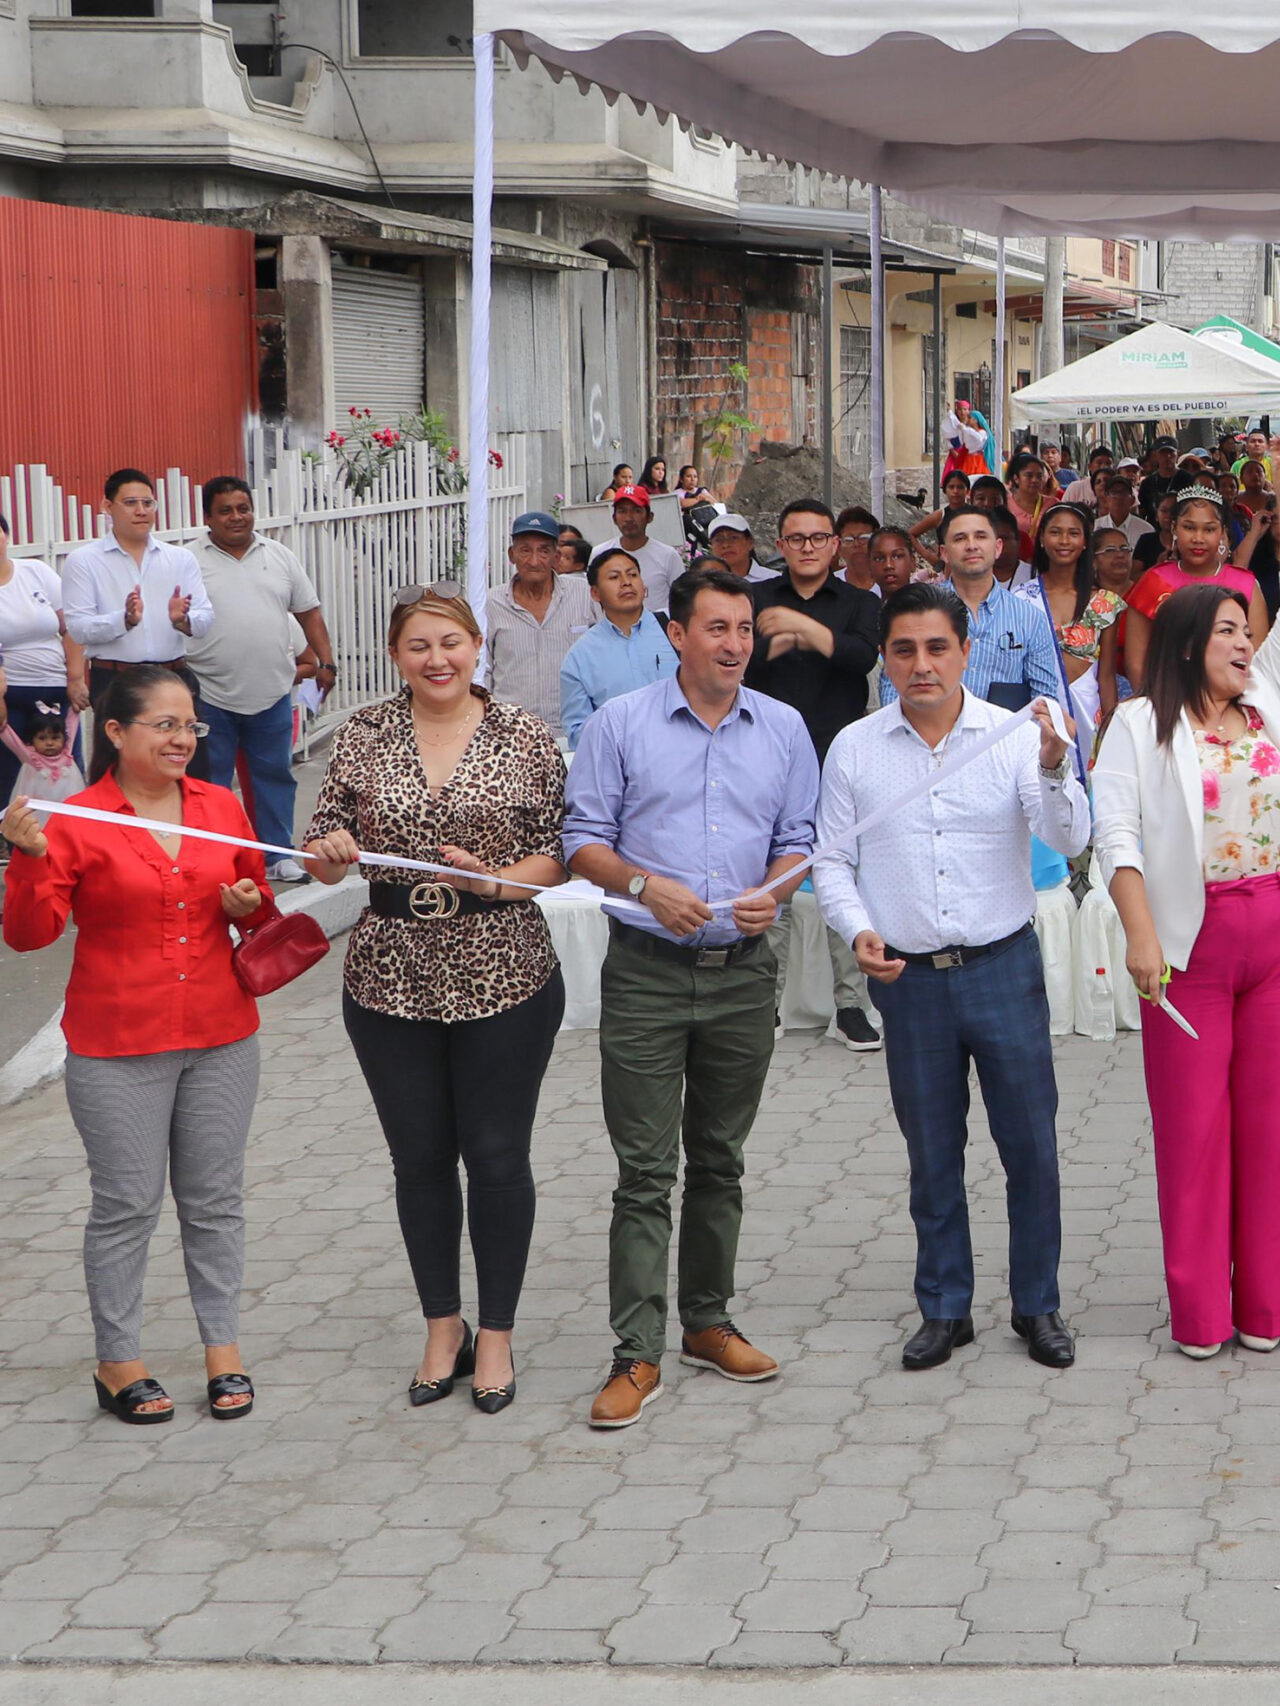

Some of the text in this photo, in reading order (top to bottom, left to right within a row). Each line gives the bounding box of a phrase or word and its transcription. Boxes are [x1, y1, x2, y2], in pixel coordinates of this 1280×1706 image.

[1095, 405, 1130, 415] PODER
[1132, 404, 1145, 413] YA
[1147, 404, 1161, 412] ES
[1163, 403, 1182, 411] DEL
[1184, 401, 1228, 411] PUEBLO!
